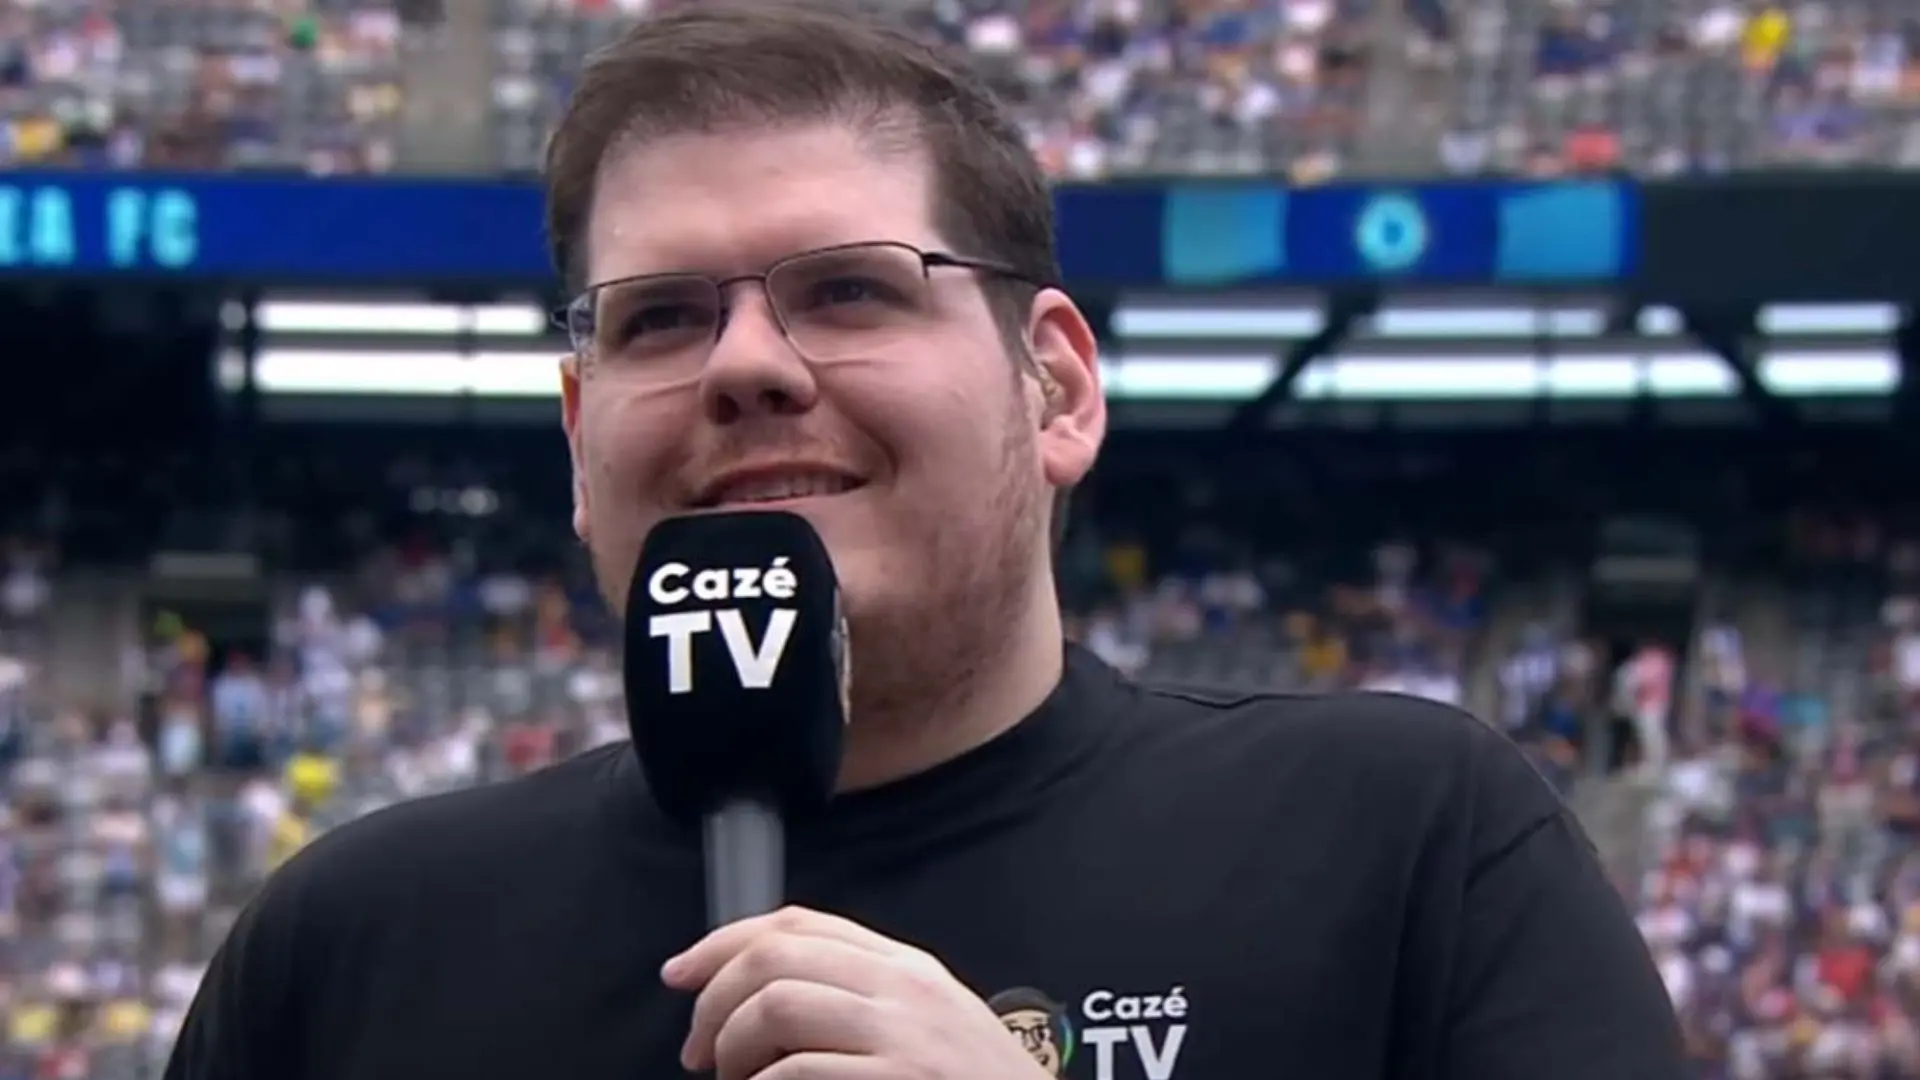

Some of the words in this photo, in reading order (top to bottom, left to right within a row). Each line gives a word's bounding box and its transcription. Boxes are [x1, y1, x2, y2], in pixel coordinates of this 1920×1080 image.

[108, 187, 197, 267] FC
[648, 556, 797, 604] Cazé
[649, 608, 798, 694] TV
[1082, 986, 1188, 1021] Cazé
[1081, 1024, 1187, 1080] TV
